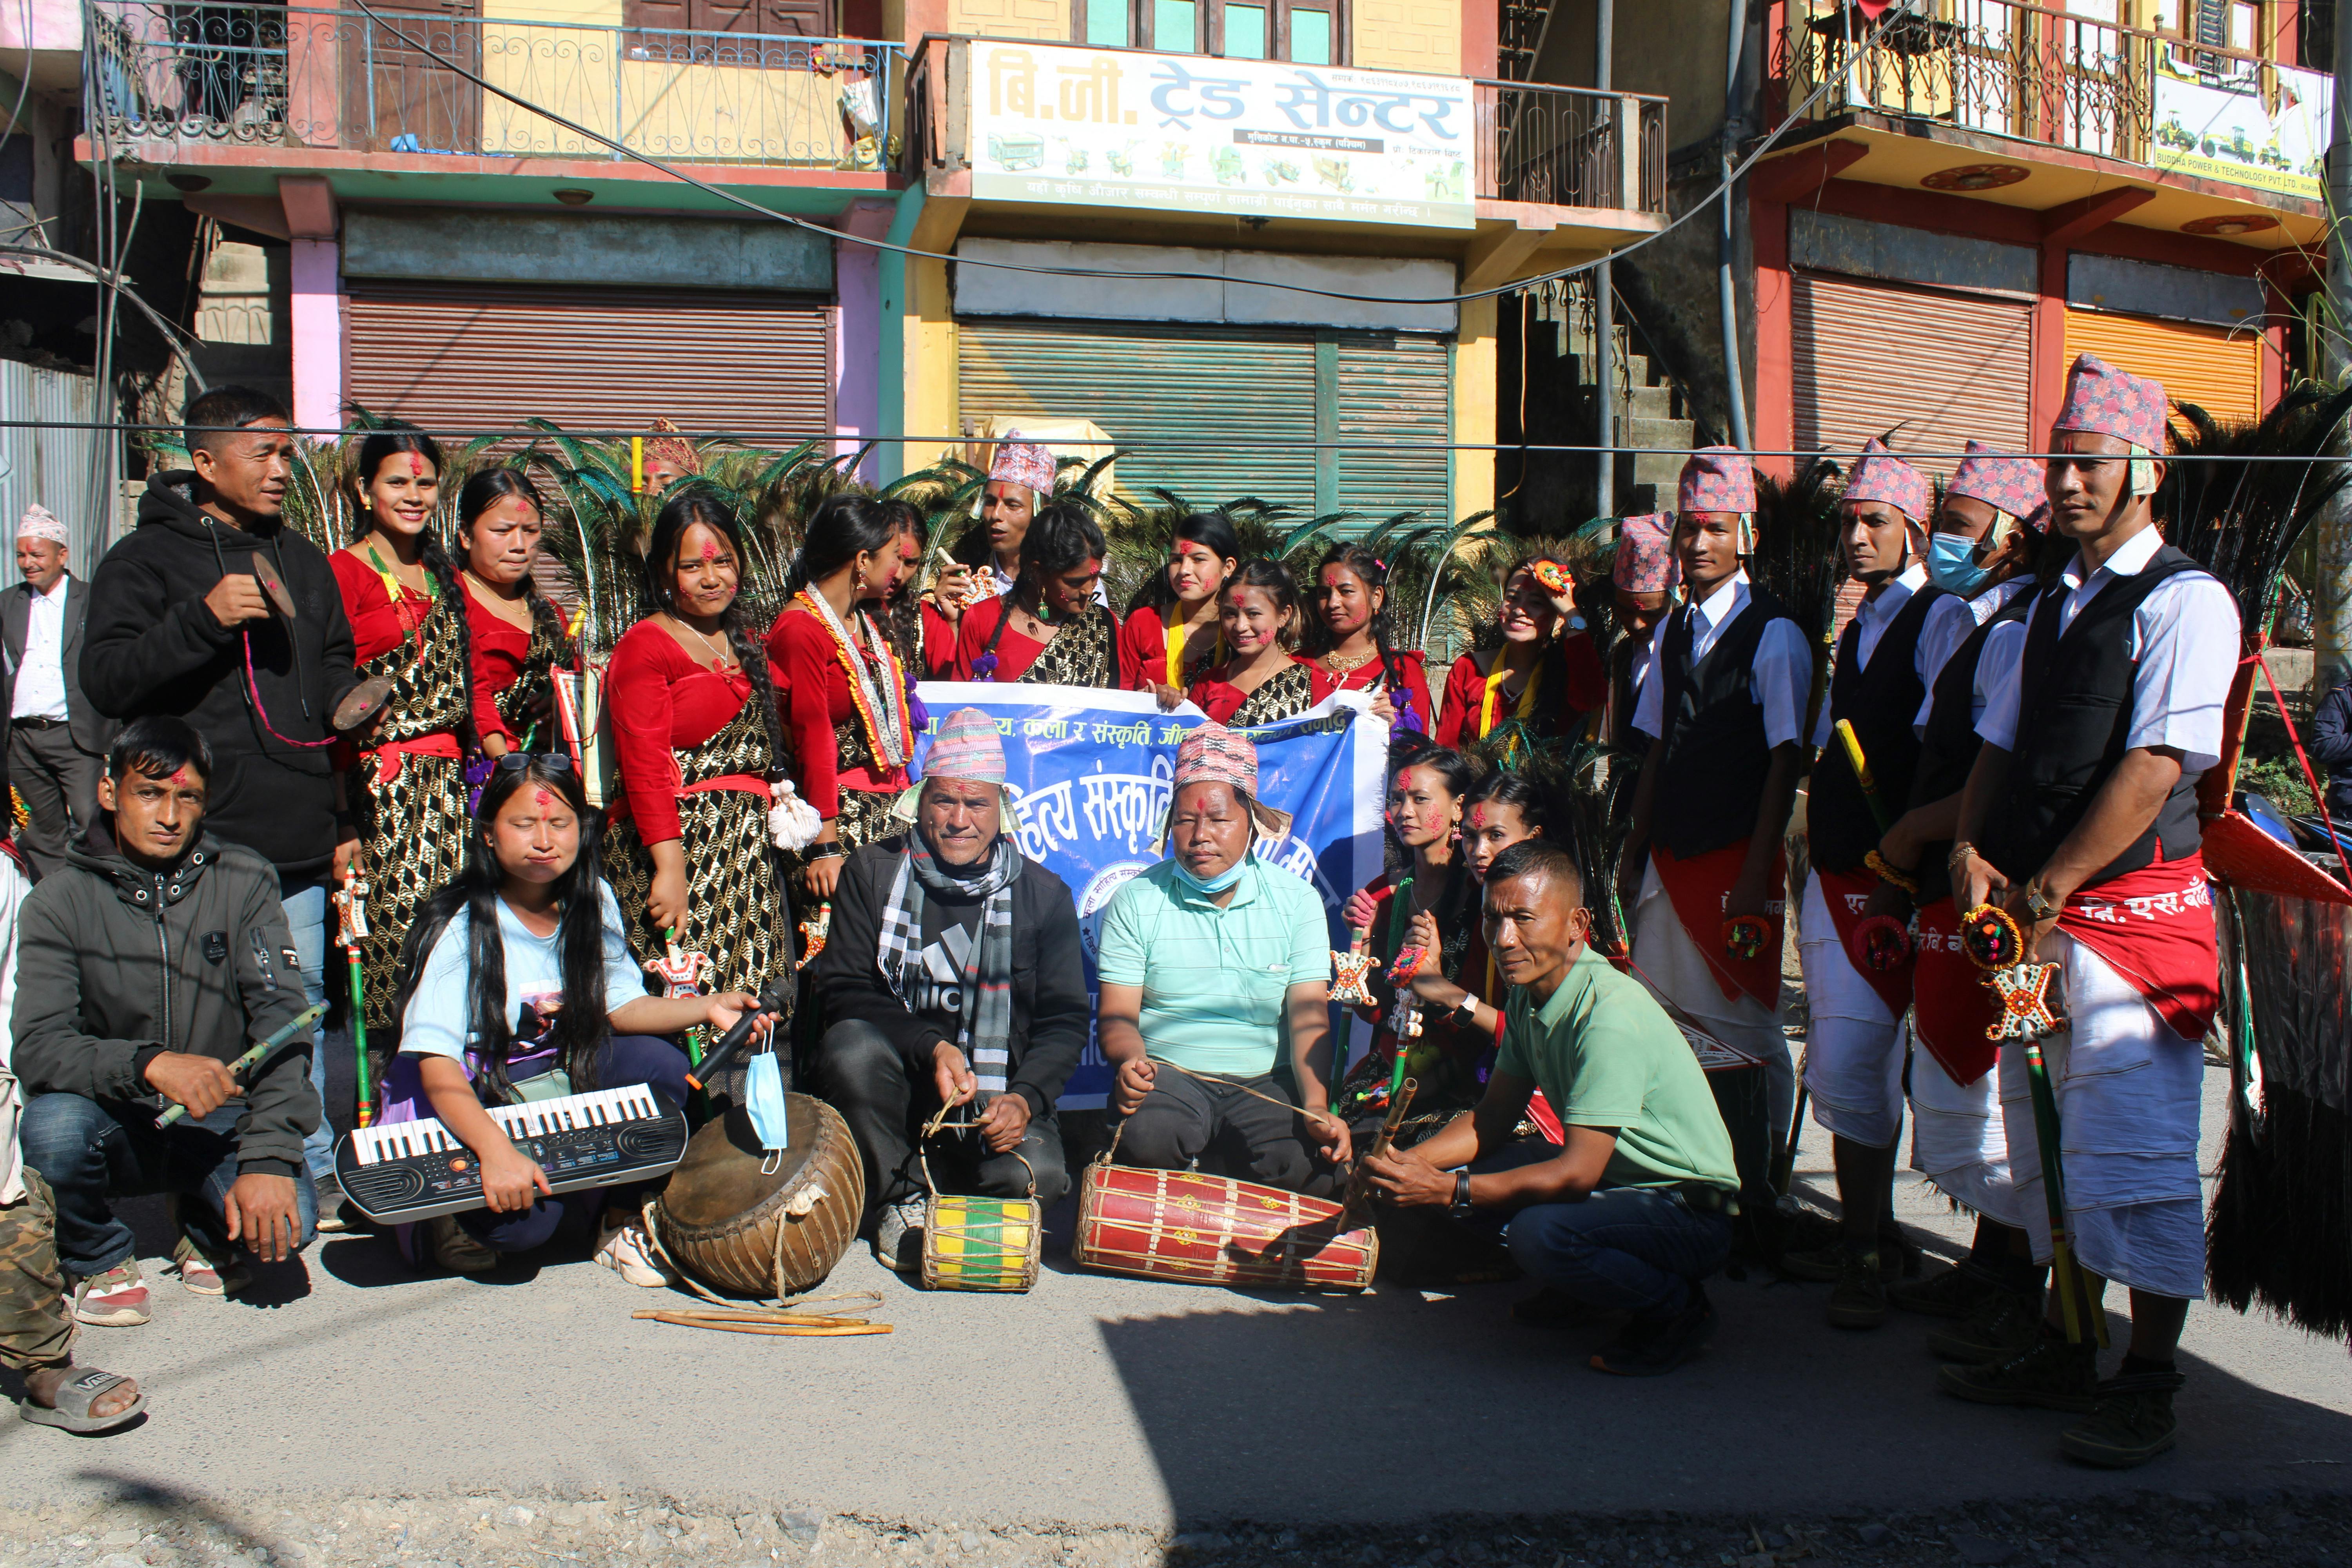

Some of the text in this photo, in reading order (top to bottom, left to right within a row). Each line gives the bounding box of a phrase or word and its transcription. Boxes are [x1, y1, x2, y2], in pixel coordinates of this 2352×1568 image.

[987, 49, 1463, 139] बि. जी. ट्रेड सेन्टर
[2157, 153, 2319, 192] BUDDHA POWER & TECHNOLOGY PVT. LTD. RUKUM
[1054, 182, 1083, 198] कृषि
[1089, 182, 1129, 200] औजार
[1024, 719, 1067, 739] कला
[1073, 722, 1086, 741] र
[1092, 720, 1152, 748] संस्कृति,
[1083, 895, 1096, 919] कला
[1093, 872, 1117, 894] साहित्य
[76, 1372, 115, 1389] VANS
